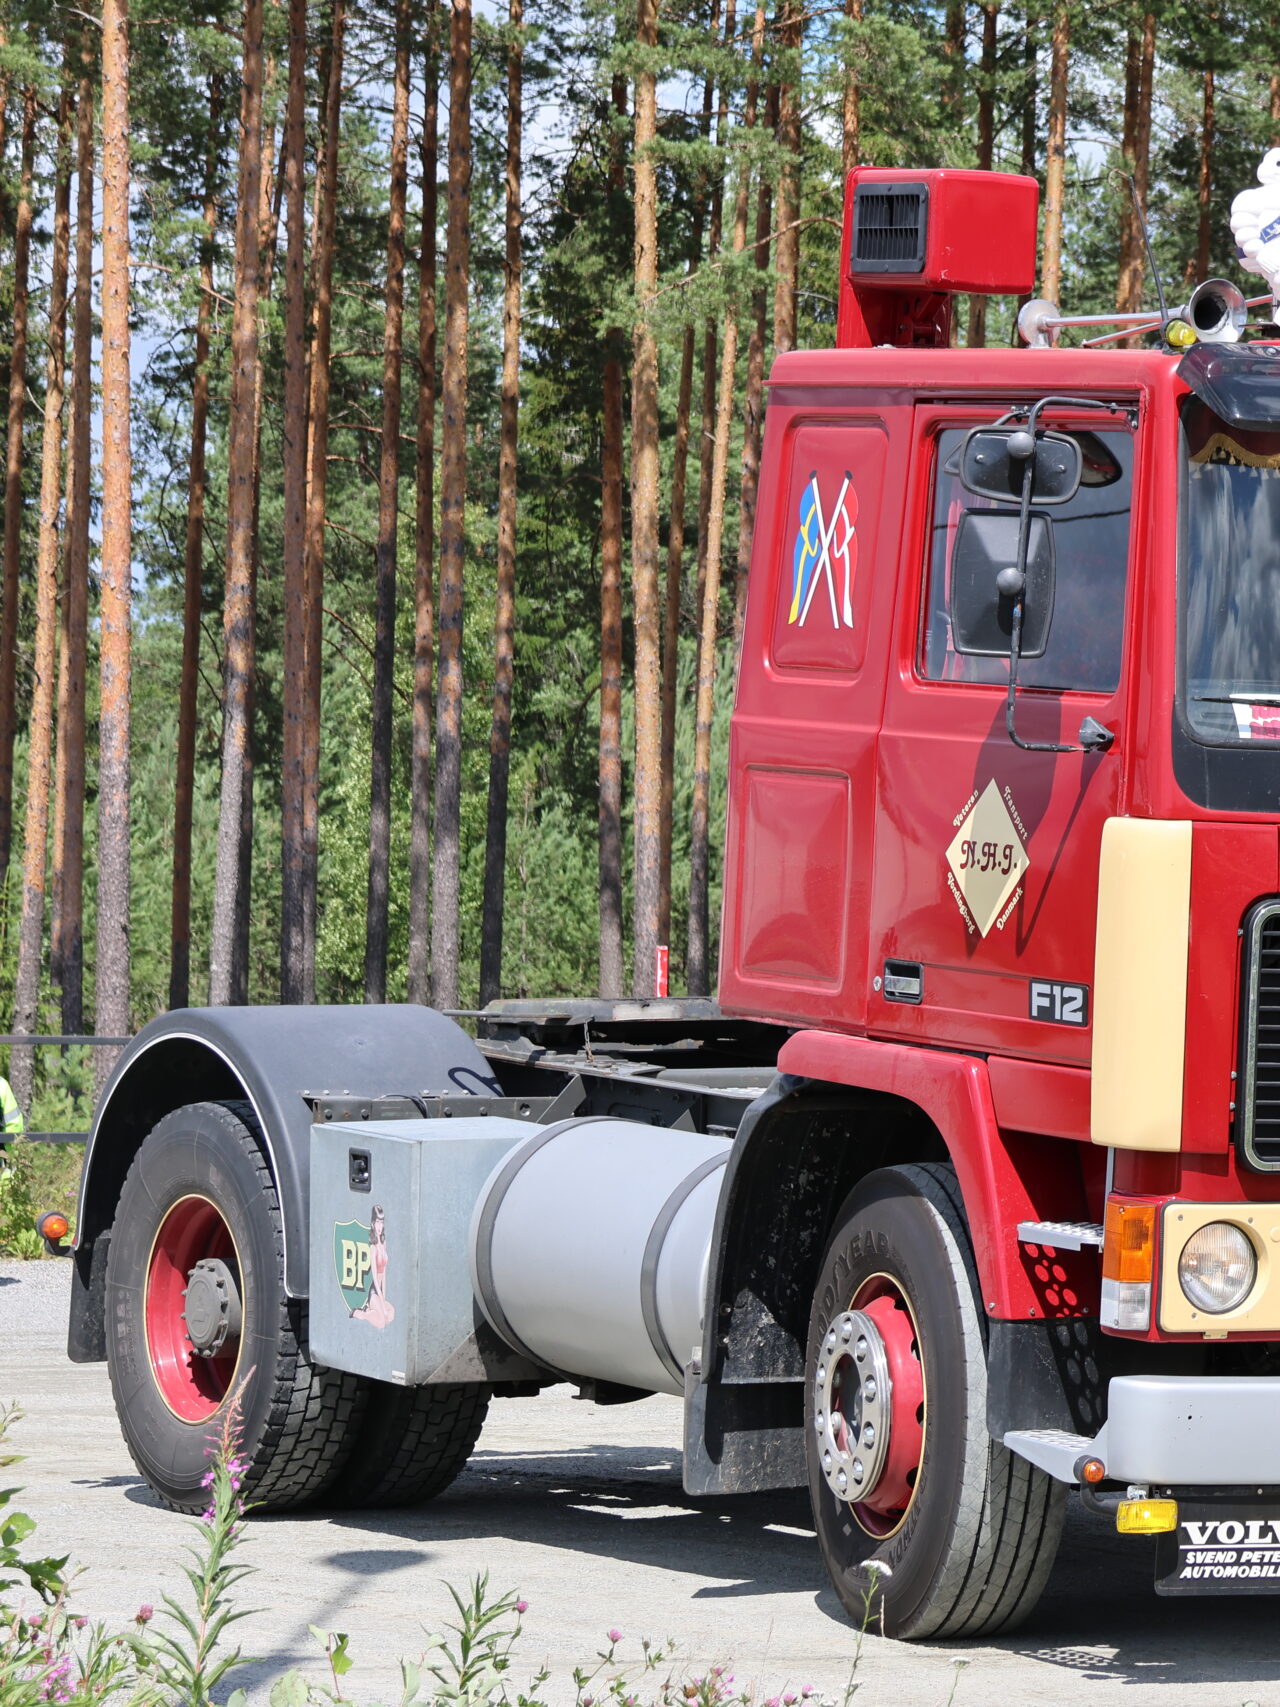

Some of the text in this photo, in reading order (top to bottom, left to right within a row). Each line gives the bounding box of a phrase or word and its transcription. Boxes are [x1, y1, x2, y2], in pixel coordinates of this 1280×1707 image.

[953, 789, 979, 827] Veteran
[1004, 785, 1028, 840] Transport
[947, 872, 975, 934] Vordingborg
[996, 886, 1023, 931] Danmark
[1032, 983, 1083, 1022] F12
[341, 1239, 371, 1291] BP
[1186, 1551, 1237, 1564] SVEND
